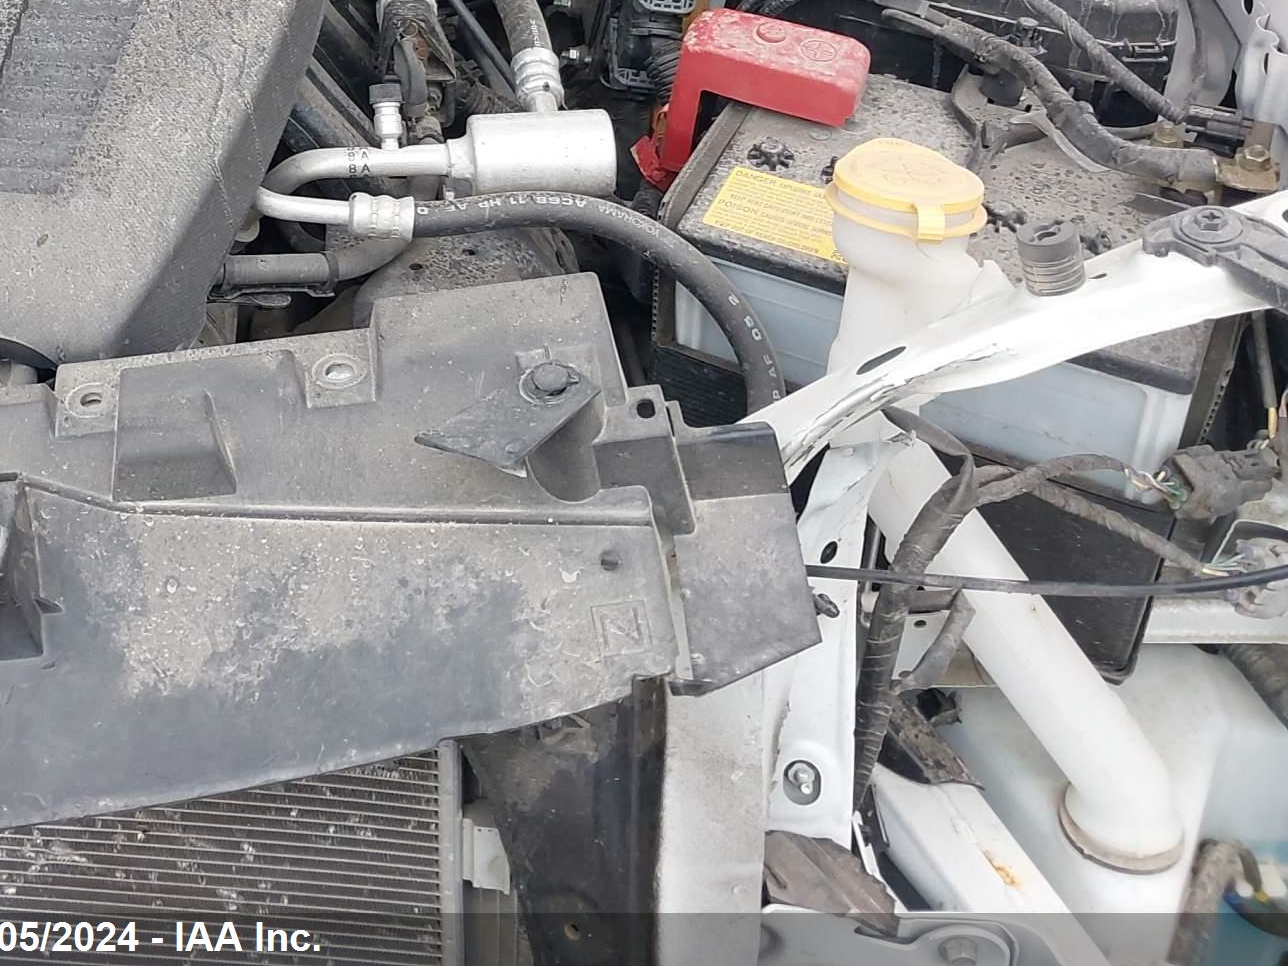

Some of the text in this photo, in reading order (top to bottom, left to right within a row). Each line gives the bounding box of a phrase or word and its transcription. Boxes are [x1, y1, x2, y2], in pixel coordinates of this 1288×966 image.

[735, 170, 777, 186] DANGER
[718, 198, 759, 215] POISON
[598, 205, 660, 237] YOKOHAMA
